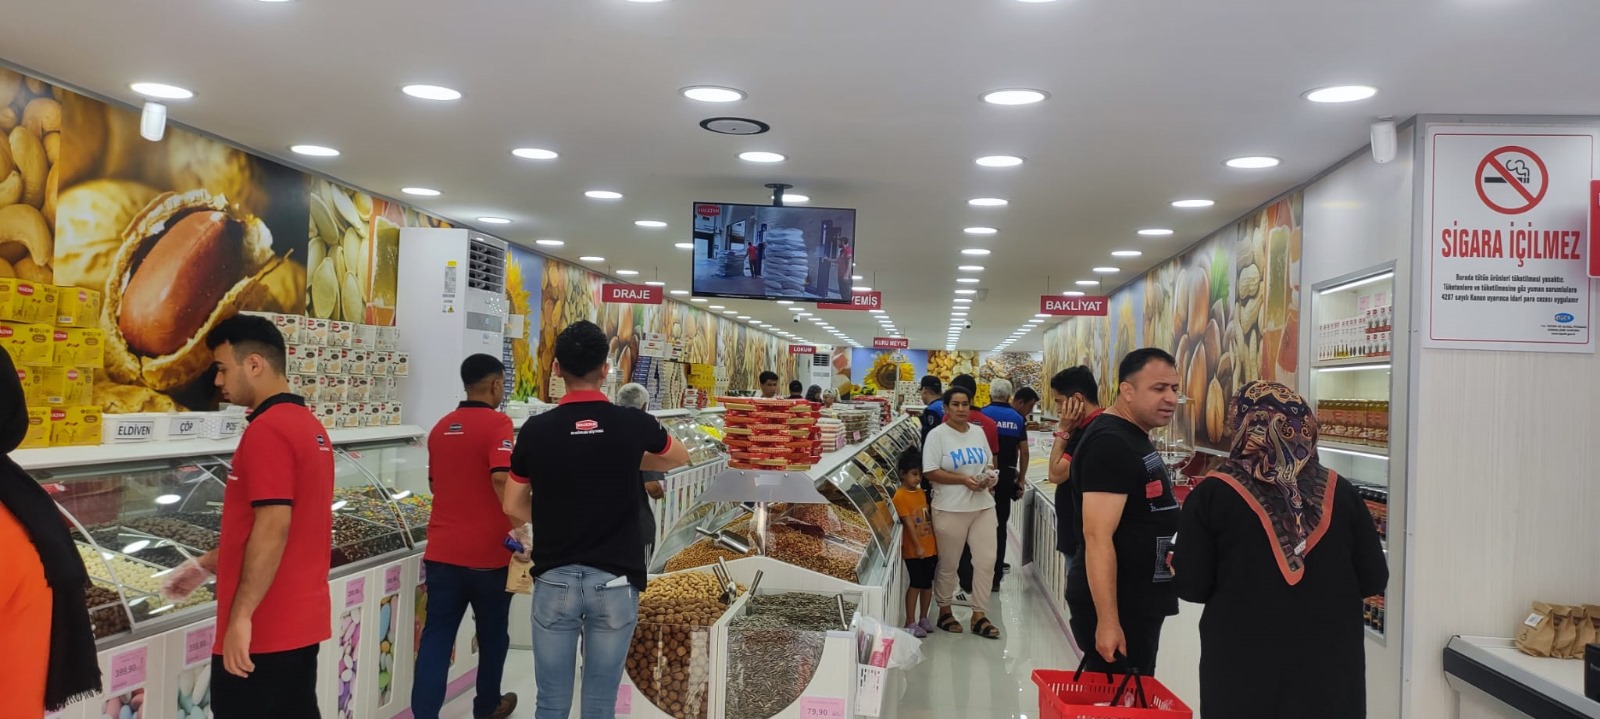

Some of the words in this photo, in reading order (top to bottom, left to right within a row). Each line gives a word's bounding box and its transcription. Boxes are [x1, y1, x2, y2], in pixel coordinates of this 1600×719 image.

[1441, 220, 1503, 258] SİGARA
[1509, 221, 1581, 267] İÇİLMEZ
[613, 289, 651, 300] DRAJE
[851, 294, 878, 307] EMİŞ
[1045, 299, 1103, 311] BAKLİYAT
[117, 423, 151, 436] ELDİVEN
[179, 421, 194, 433] ÇÖP
[995, 420, 1018, 430] ABITA
[807, 707, 828, 717] 79,90
